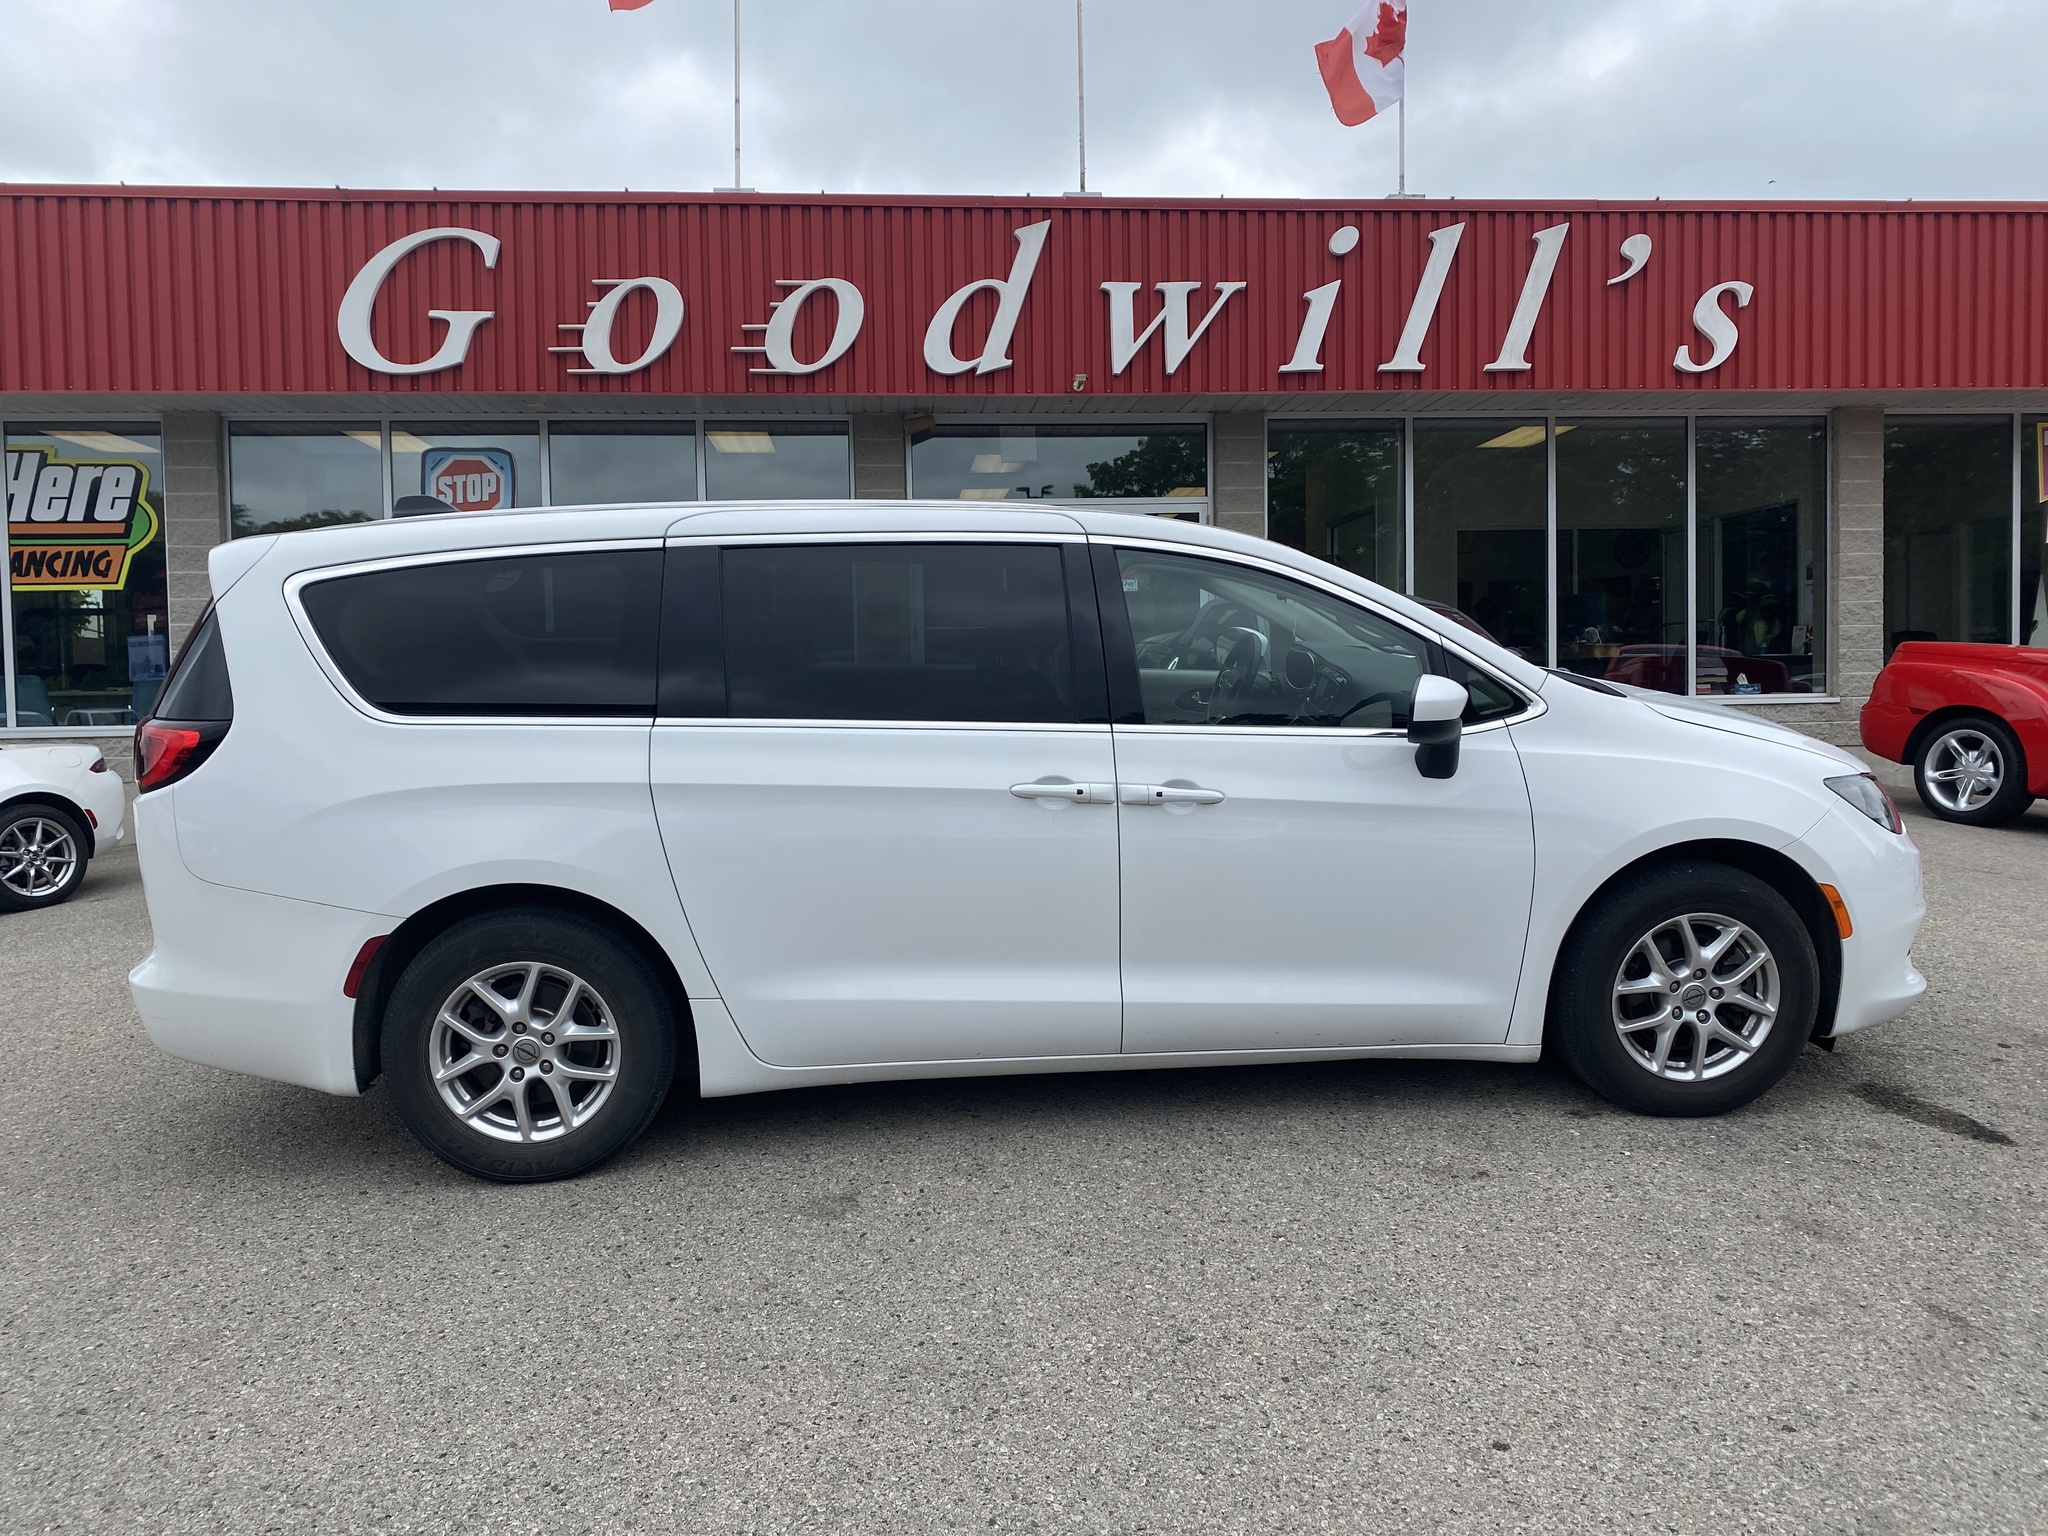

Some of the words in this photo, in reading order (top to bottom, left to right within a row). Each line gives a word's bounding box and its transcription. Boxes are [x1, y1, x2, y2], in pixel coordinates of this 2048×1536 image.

[337, 219, 1754, 376] Goodwill's
[6, 452, 136, 522] Here
[437, 472, 497, 505] STOP
[11, 550, 114, 578] ANCING
